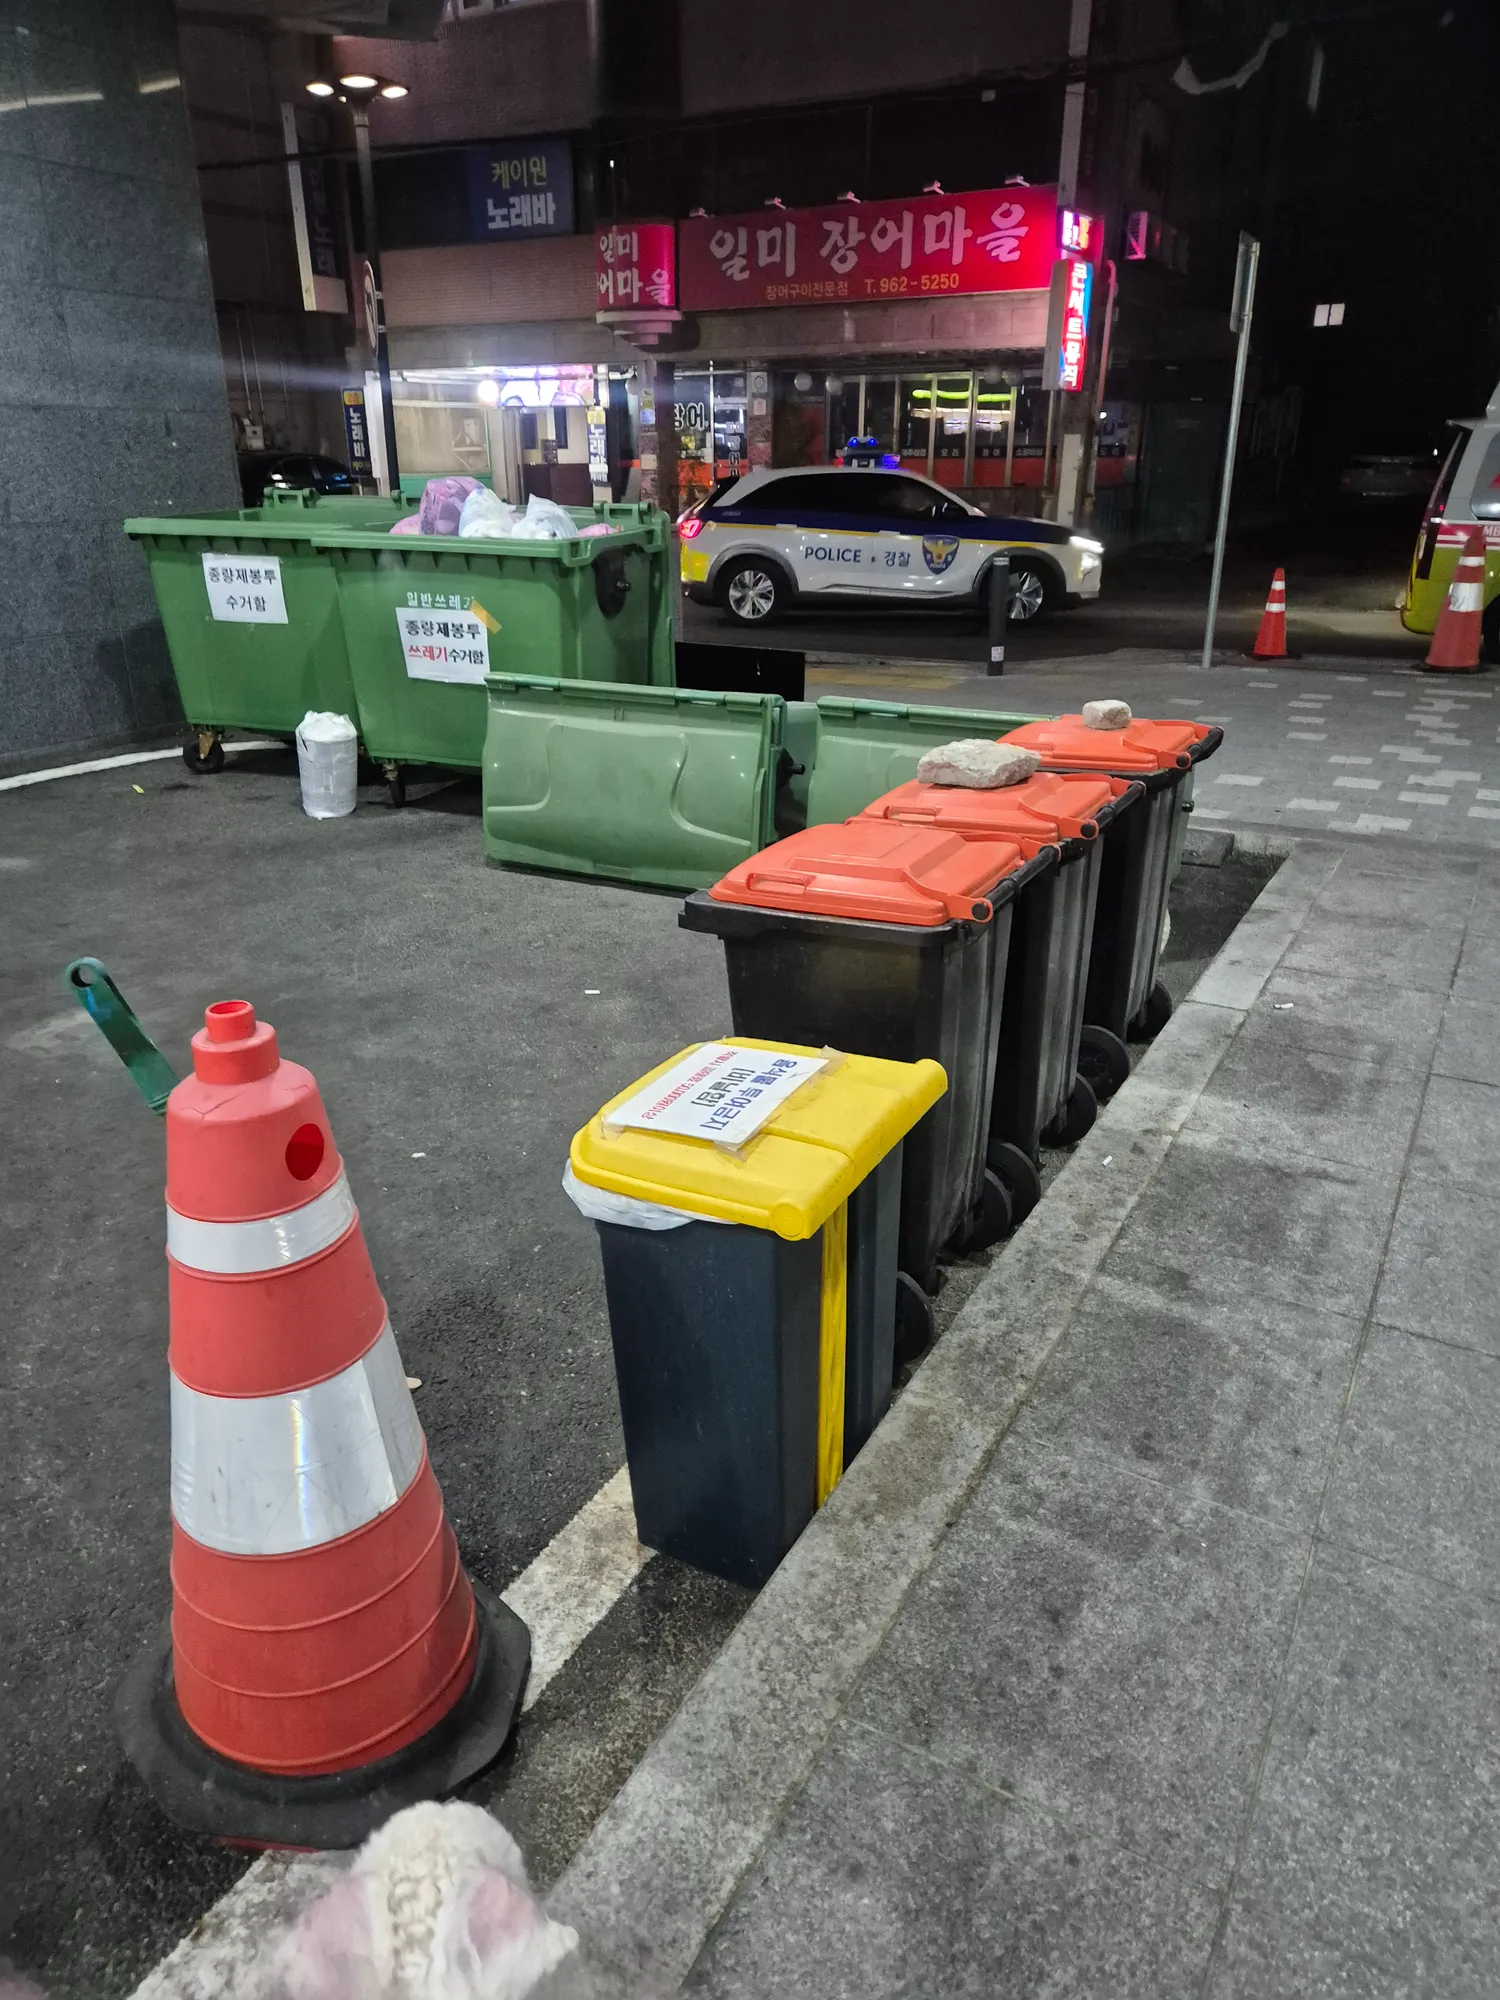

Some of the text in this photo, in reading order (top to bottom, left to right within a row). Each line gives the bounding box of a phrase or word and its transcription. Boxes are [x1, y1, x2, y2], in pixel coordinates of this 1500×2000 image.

[491, 155, 547, 189] 케이원
[487, 191, 557, 230] 노래바
[599, 231, 638, 263] 일미
[709, 221, 797, 281] 일미
[818, 202, 1030, 274] 장어마을
[349, 407, 366, 458] 노래바
[804, 546, 862, 563] POLICE
[884, 551, 912, 567] 경찰
[208, 567, 278, 585] 종량제봉투
[226, 594, 267, 612] 수거함
[404, 619, 481, 640] 종량제봉투
[699, 1059, 798, 1130] 음식물 투여금지
